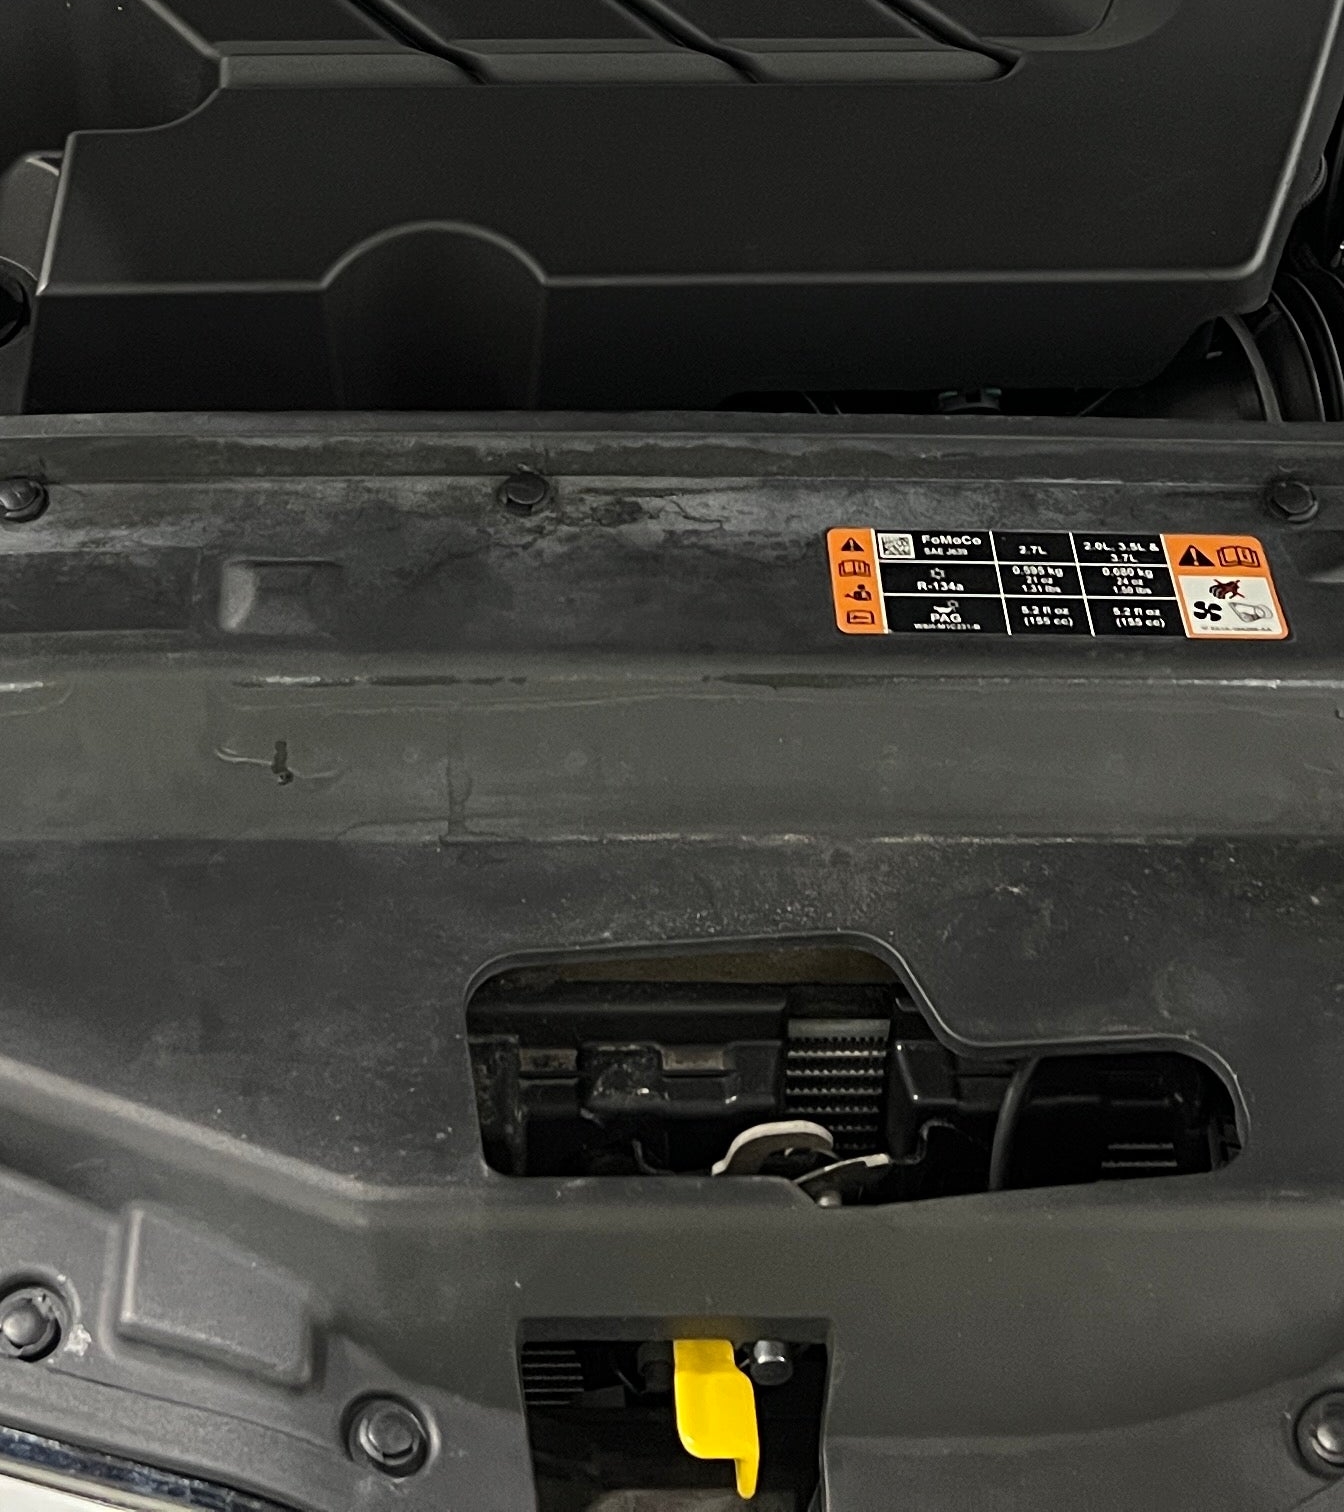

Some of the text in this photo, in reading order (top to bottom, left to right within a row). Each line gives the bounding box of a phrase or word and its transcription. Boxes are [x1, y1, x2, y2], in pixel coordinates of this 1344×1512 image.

[921, 534, 982, 545] FoMoCo
[1018, 545, 1048, 555] 2.7L
[1117, 542, 1146, 552] 3.5L
[1149, 543, 1160, 552] &
[1110, 553, 1139, 562] 3.7L
[1047, 566, 1064, 578] kg
[1137, 567, 1154, 579] kg
[1026, 575, 1038, 584] 21
[1117, 576, 1144, 586] 24 oz
[916, 580, 965, 591] R-134a
[1021, 605, 1070, 615] 5.2 fl oz
[1112, 606, 1161, 616] 5.2 fl oz
[930, 612, 962, 623] PAG
[1023, 616, 1073, 627] (155 cc)
[1115, 617, 1166, 628] (155 cc)
